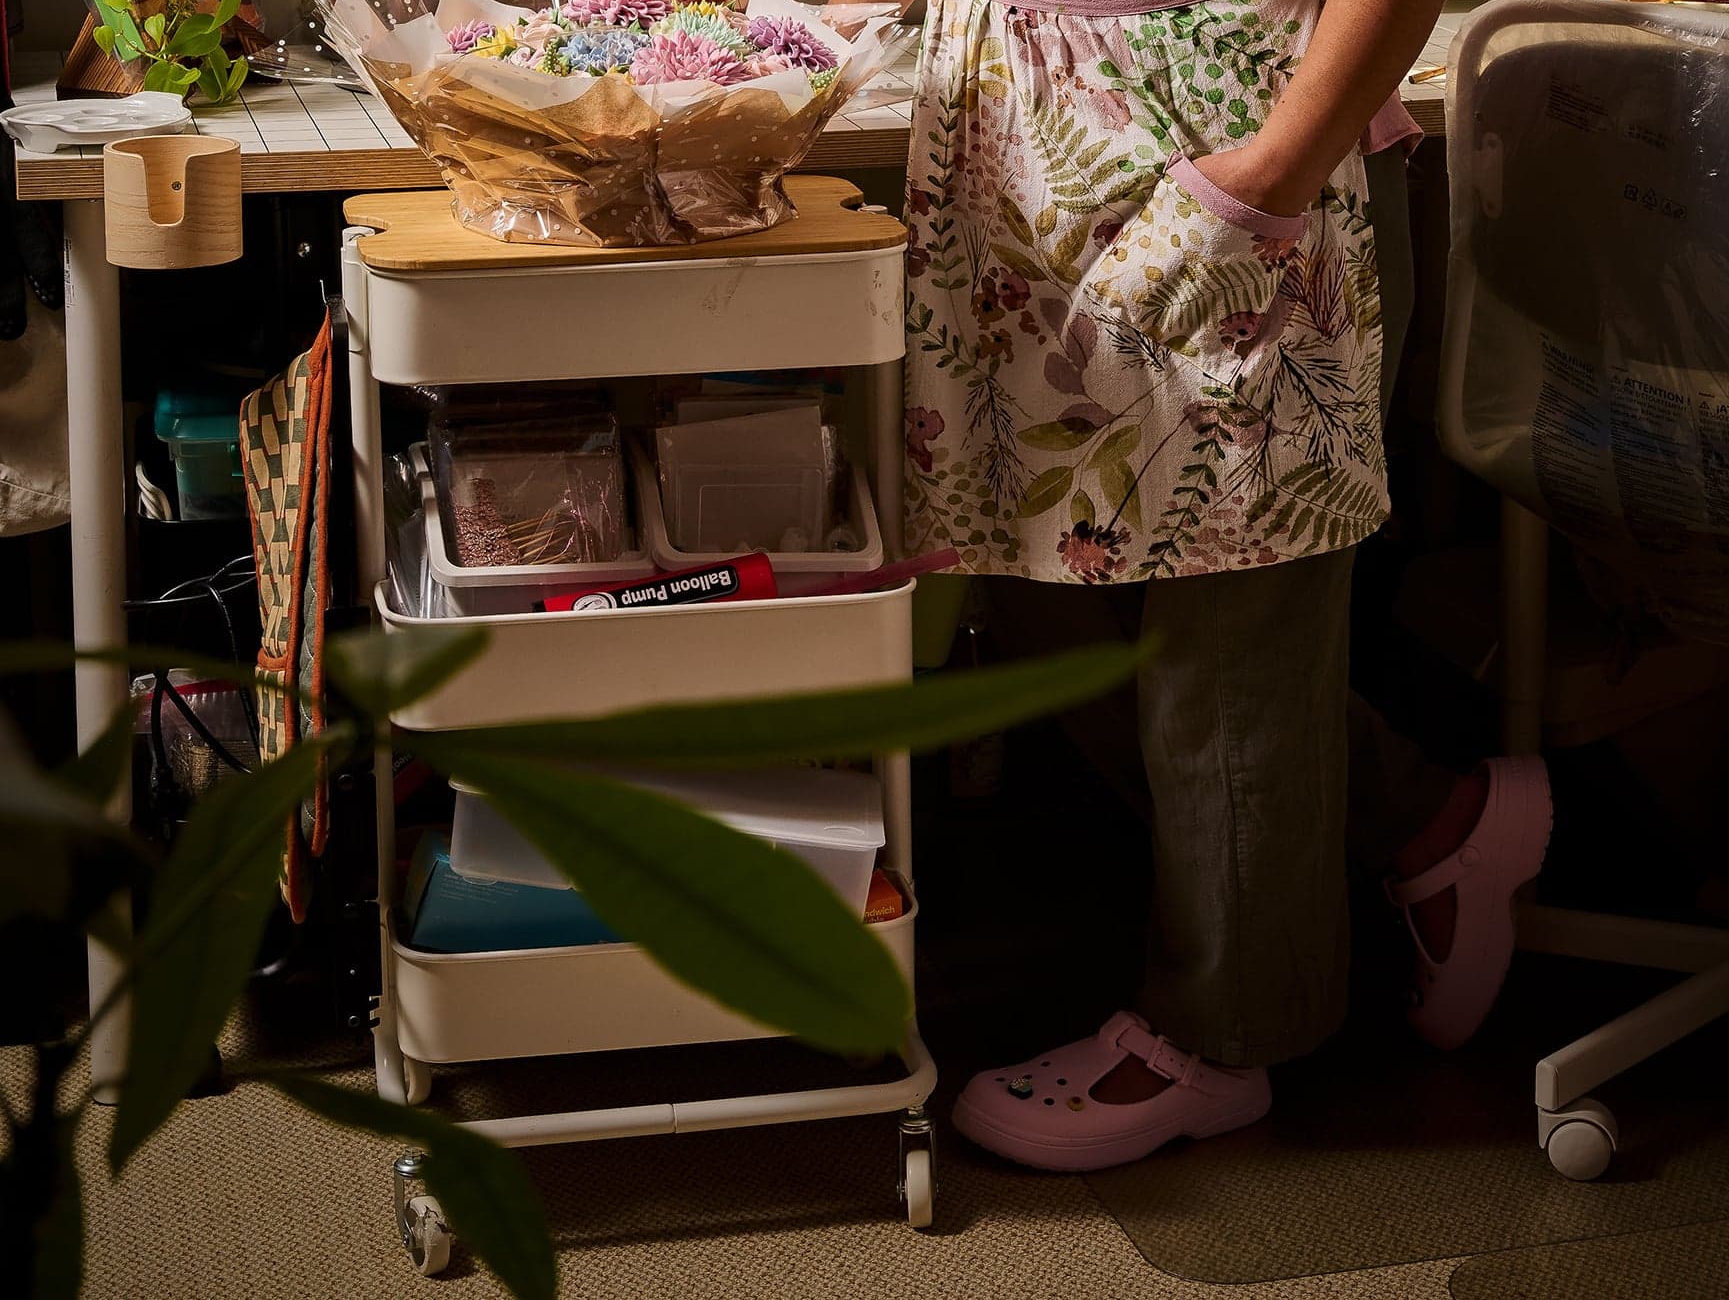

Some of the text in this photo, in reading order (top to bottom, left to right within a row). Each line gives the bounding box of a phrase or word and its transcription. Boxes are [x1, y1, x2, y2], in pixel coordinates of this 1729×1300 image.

[1624, 378, 1684, 405] ATTENTION
[671, 570, 732, 594] Balloon
[621, 585, 668, 606] Pump
